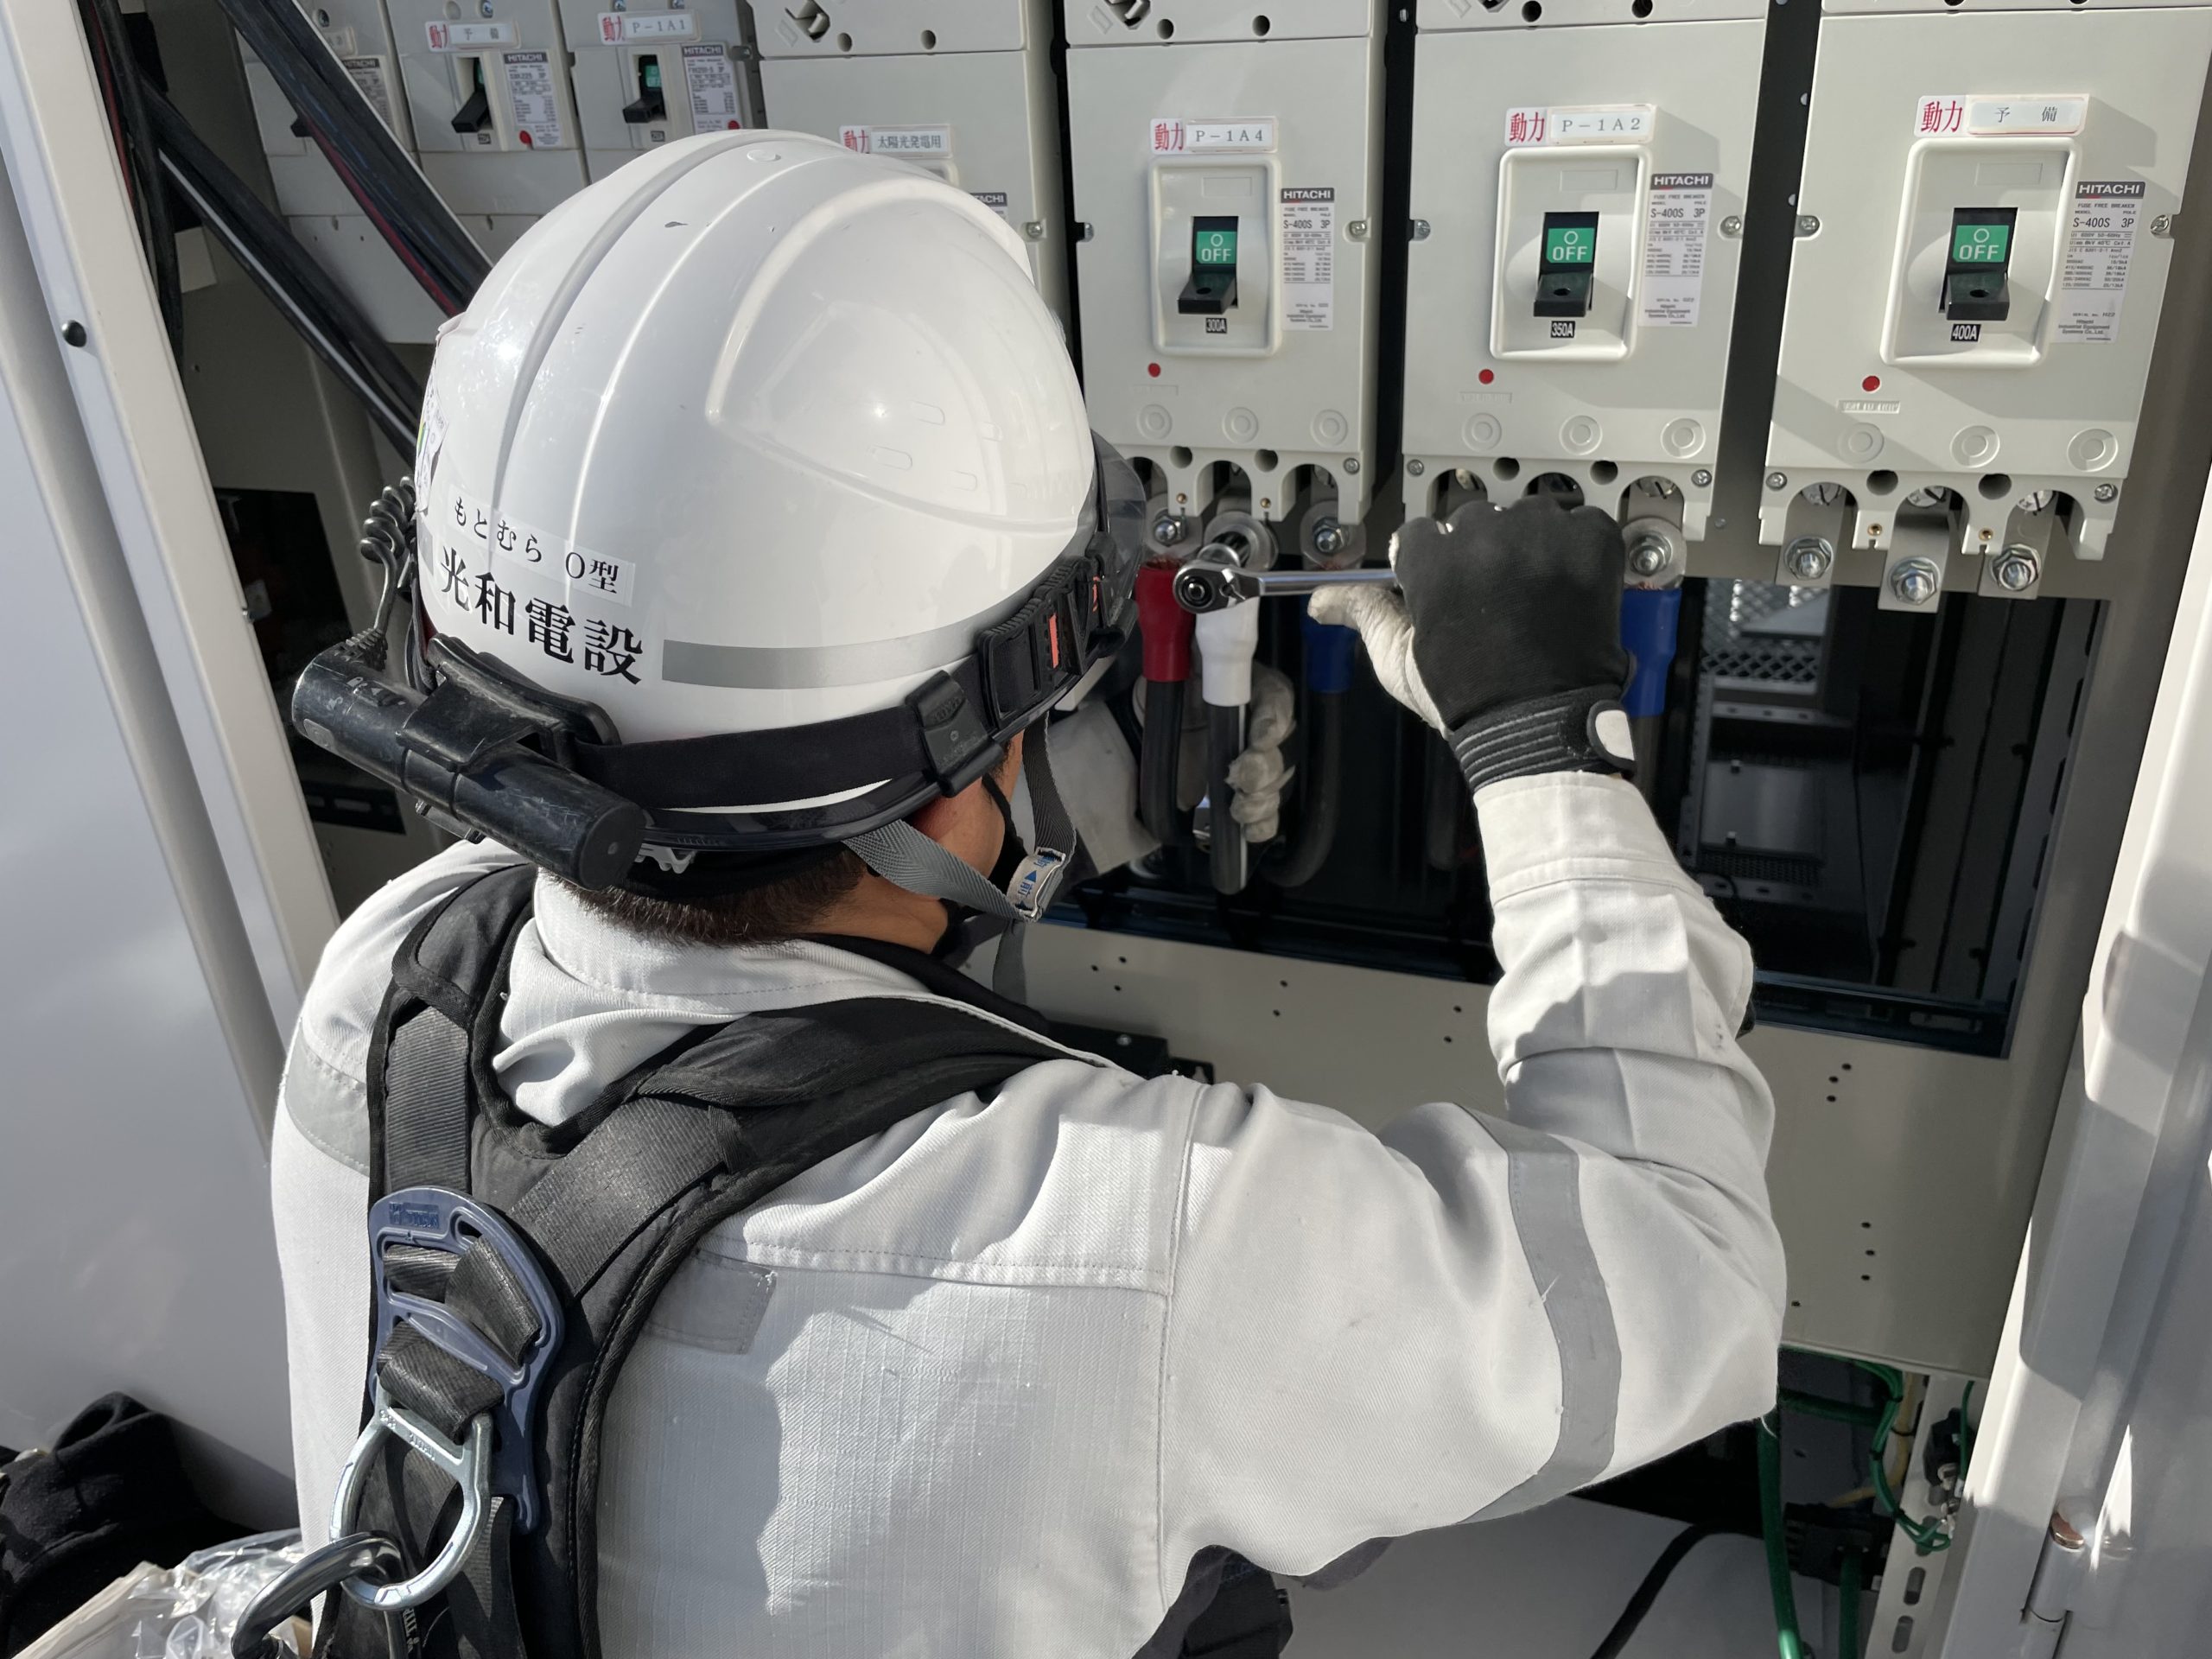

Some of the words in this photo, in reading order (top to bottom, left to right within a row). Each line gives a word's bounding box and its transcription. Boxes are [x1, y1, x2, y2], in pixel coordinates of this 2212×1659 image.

[683, 47, 721, 55] HITACHI
[1921, 100, 1963, 133] 動力
[1995, 106, 2058, 123] 予備
[1510, 111, 1545, 143] 動力
[1562, 118, 1641, 132] P-1A2
[878, 135, 942, 149] 太陽光発電用
[1154, 123, 1185, 151] 動力
[1196, 129, 1263, 142] P-1A4
[1654, 175, 1709, 186] HITACHI
[1283, 190, 1331, 199] HITACHI
[2078, 184, 2140, 194] HITACHI
[1650, 208, 1684, 218] S-400S
[1694, 208, 1706, 218] 3P
[1283, 219, 1313, 229] S-400S
[1320, 219, 1331, 229] 3P
[2073, 218, 2110, 227] S-400S
[2121, 218, 2134, 227] 3P
[1201, 248, 1232, 262] OFF
[1553, 246, 1588, 261] OFF
[1959, 245, 2000, 260] OFF
[1552, 322, 1573, 337] 350A
[1953, 325, 1977, 340] 400A
[454, 496, 543, 563] もとむら
[441, 545, 644, 685] 光和電設
